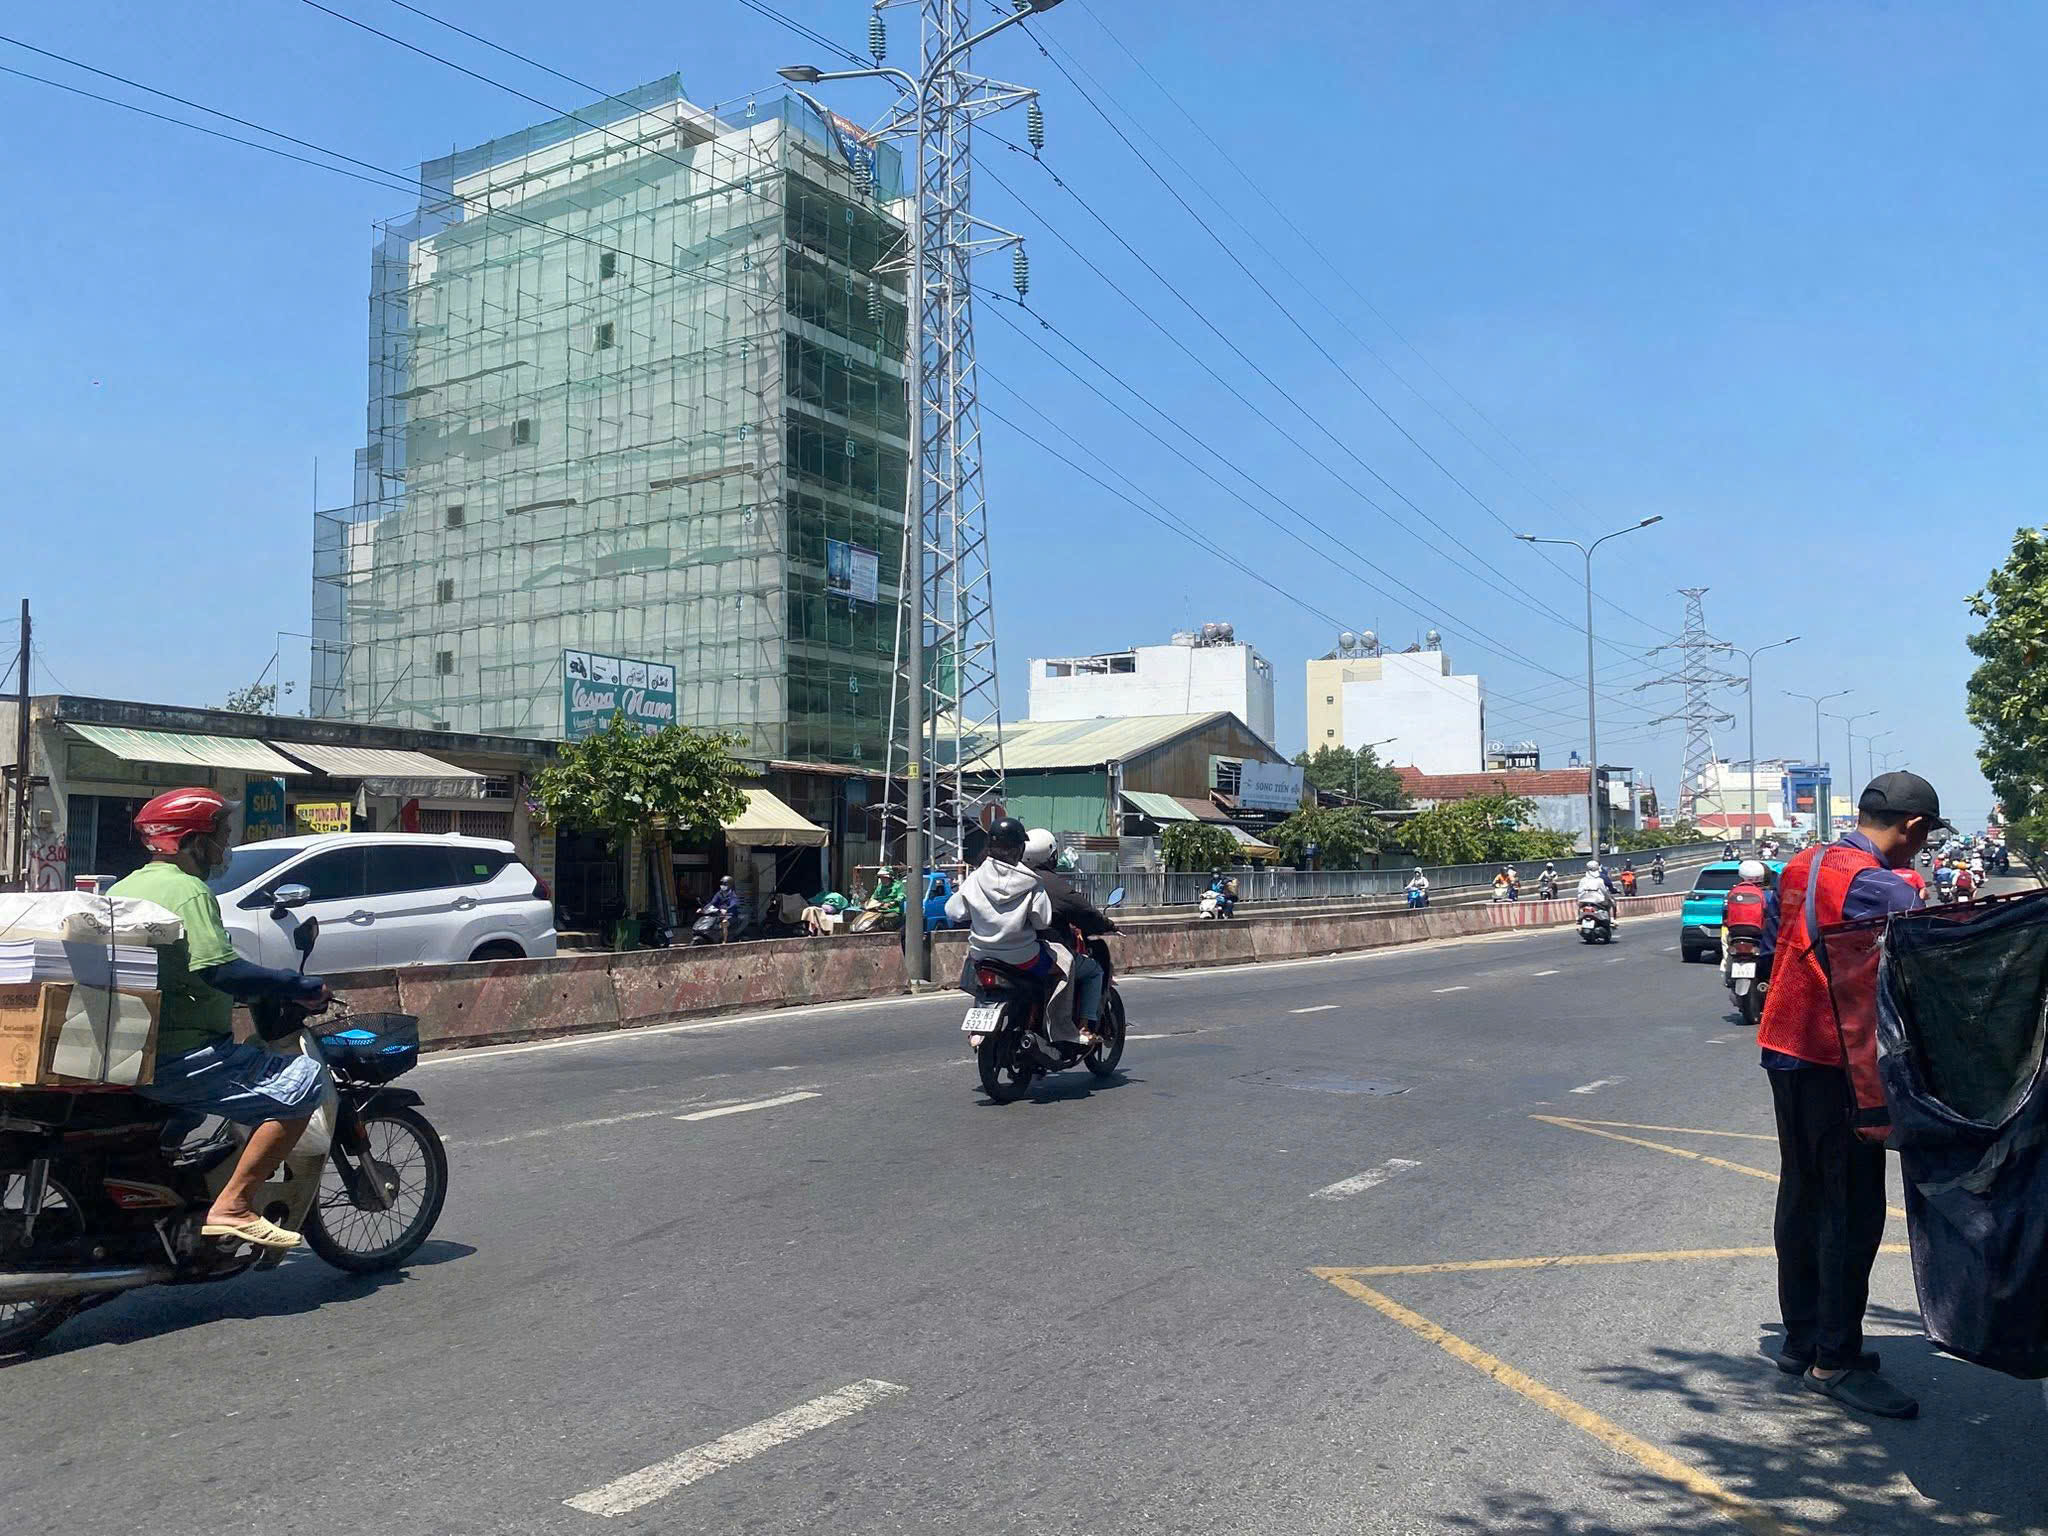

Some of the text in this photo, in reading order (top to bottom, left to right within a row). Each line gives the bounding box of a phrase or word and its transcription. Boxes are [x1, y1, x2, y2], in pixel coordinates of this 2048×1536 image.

[747, 102, 755, 116] 10
[739, 426, 746, 440] 6
[745, 507, 753, 522] 5
[571, 680, 674, 720] Vespa Nam
